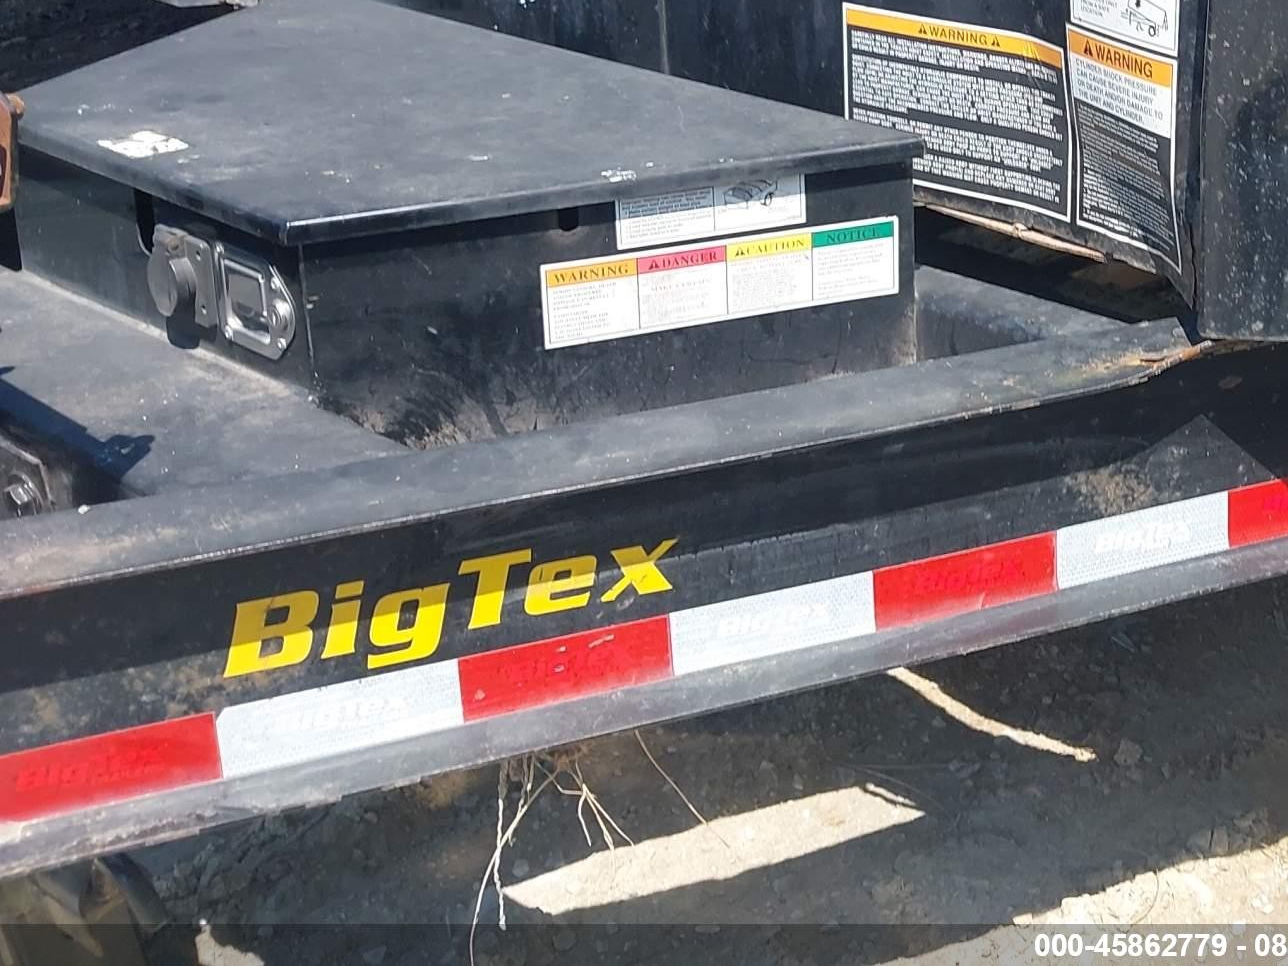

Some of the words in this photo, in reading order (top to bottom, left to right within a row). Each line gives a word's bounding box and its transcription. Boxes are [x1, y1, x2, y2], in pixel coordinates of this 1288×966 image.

[929, 25, 988, 45] WARNING
[1095, 43, 1153, 79] WARNING
[826, 228, 881, 244] NOTICE
[745, 238, 805, 255] CAUTION
[660, 250, 718, 269] DANGER
[553, 263, 630, 284] WARNING
[221, 537, 679, 679] BigTex
